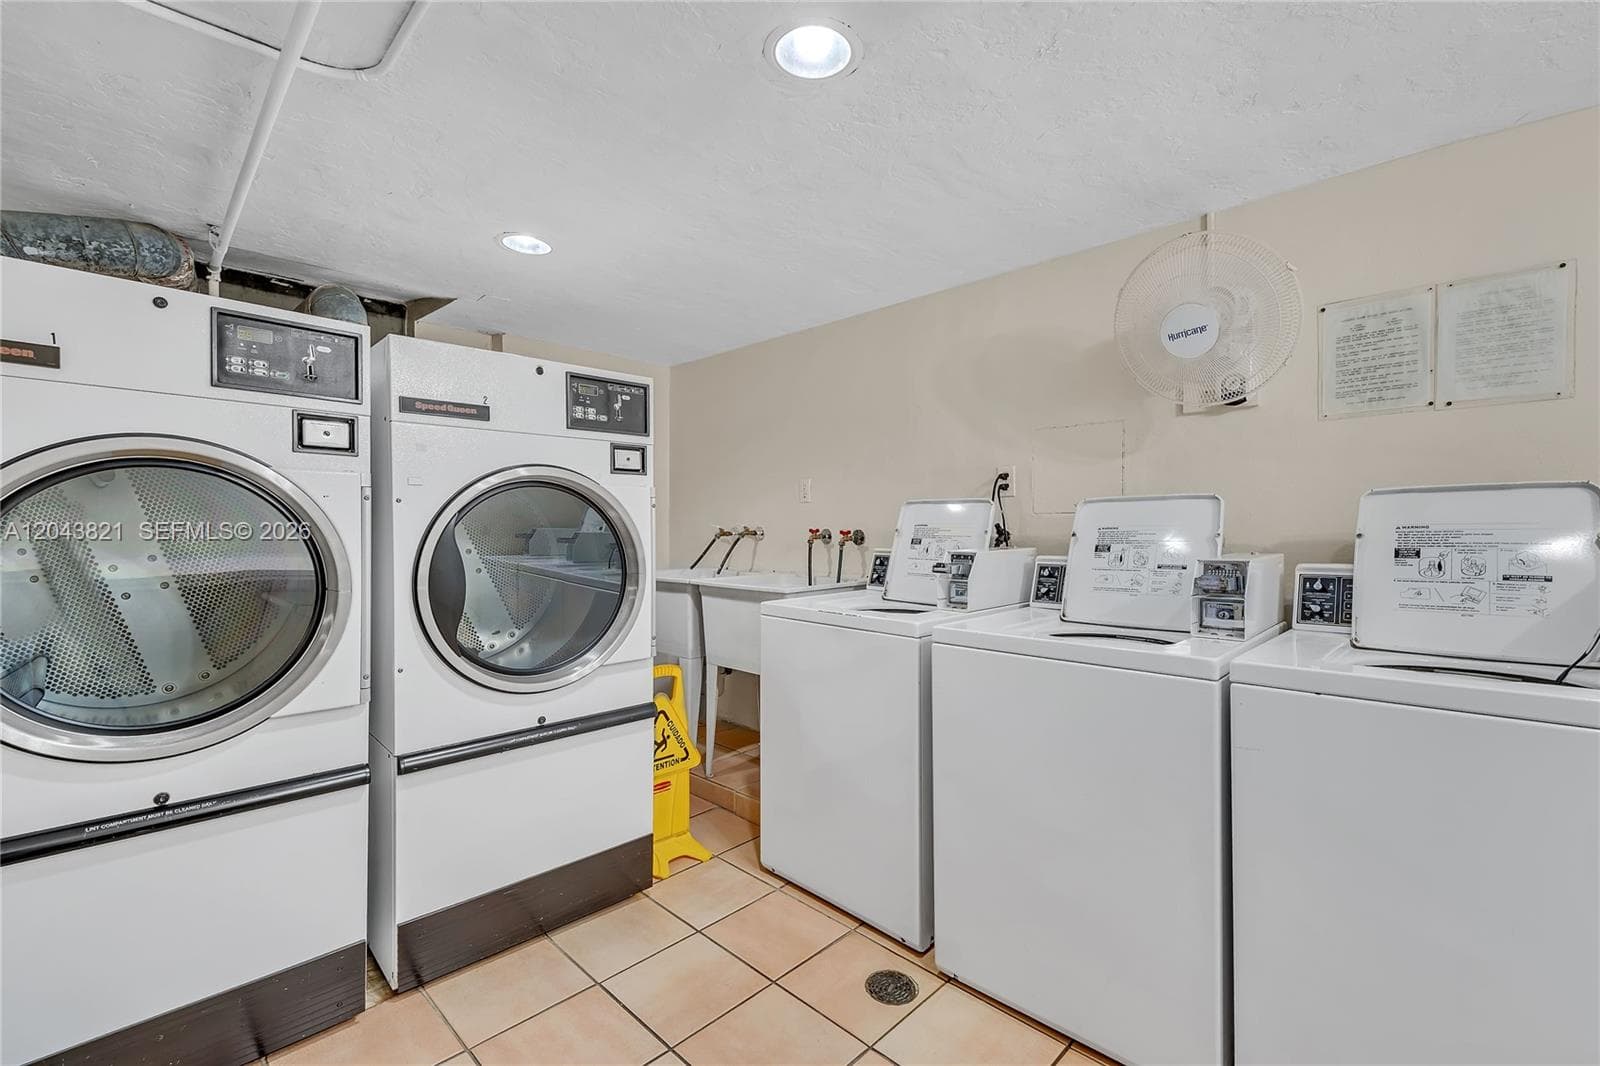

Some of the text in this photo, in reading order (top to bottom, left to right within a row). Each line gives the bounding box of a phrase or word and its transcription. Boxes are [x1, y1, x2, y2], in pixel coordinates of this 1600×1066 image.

[50, 332, 56, 344] 1
[1167, 324, 1207, 342] Hurricane
[482, 395, 489, 405] 2
[667, 720, 685, 748] CUIDADO
